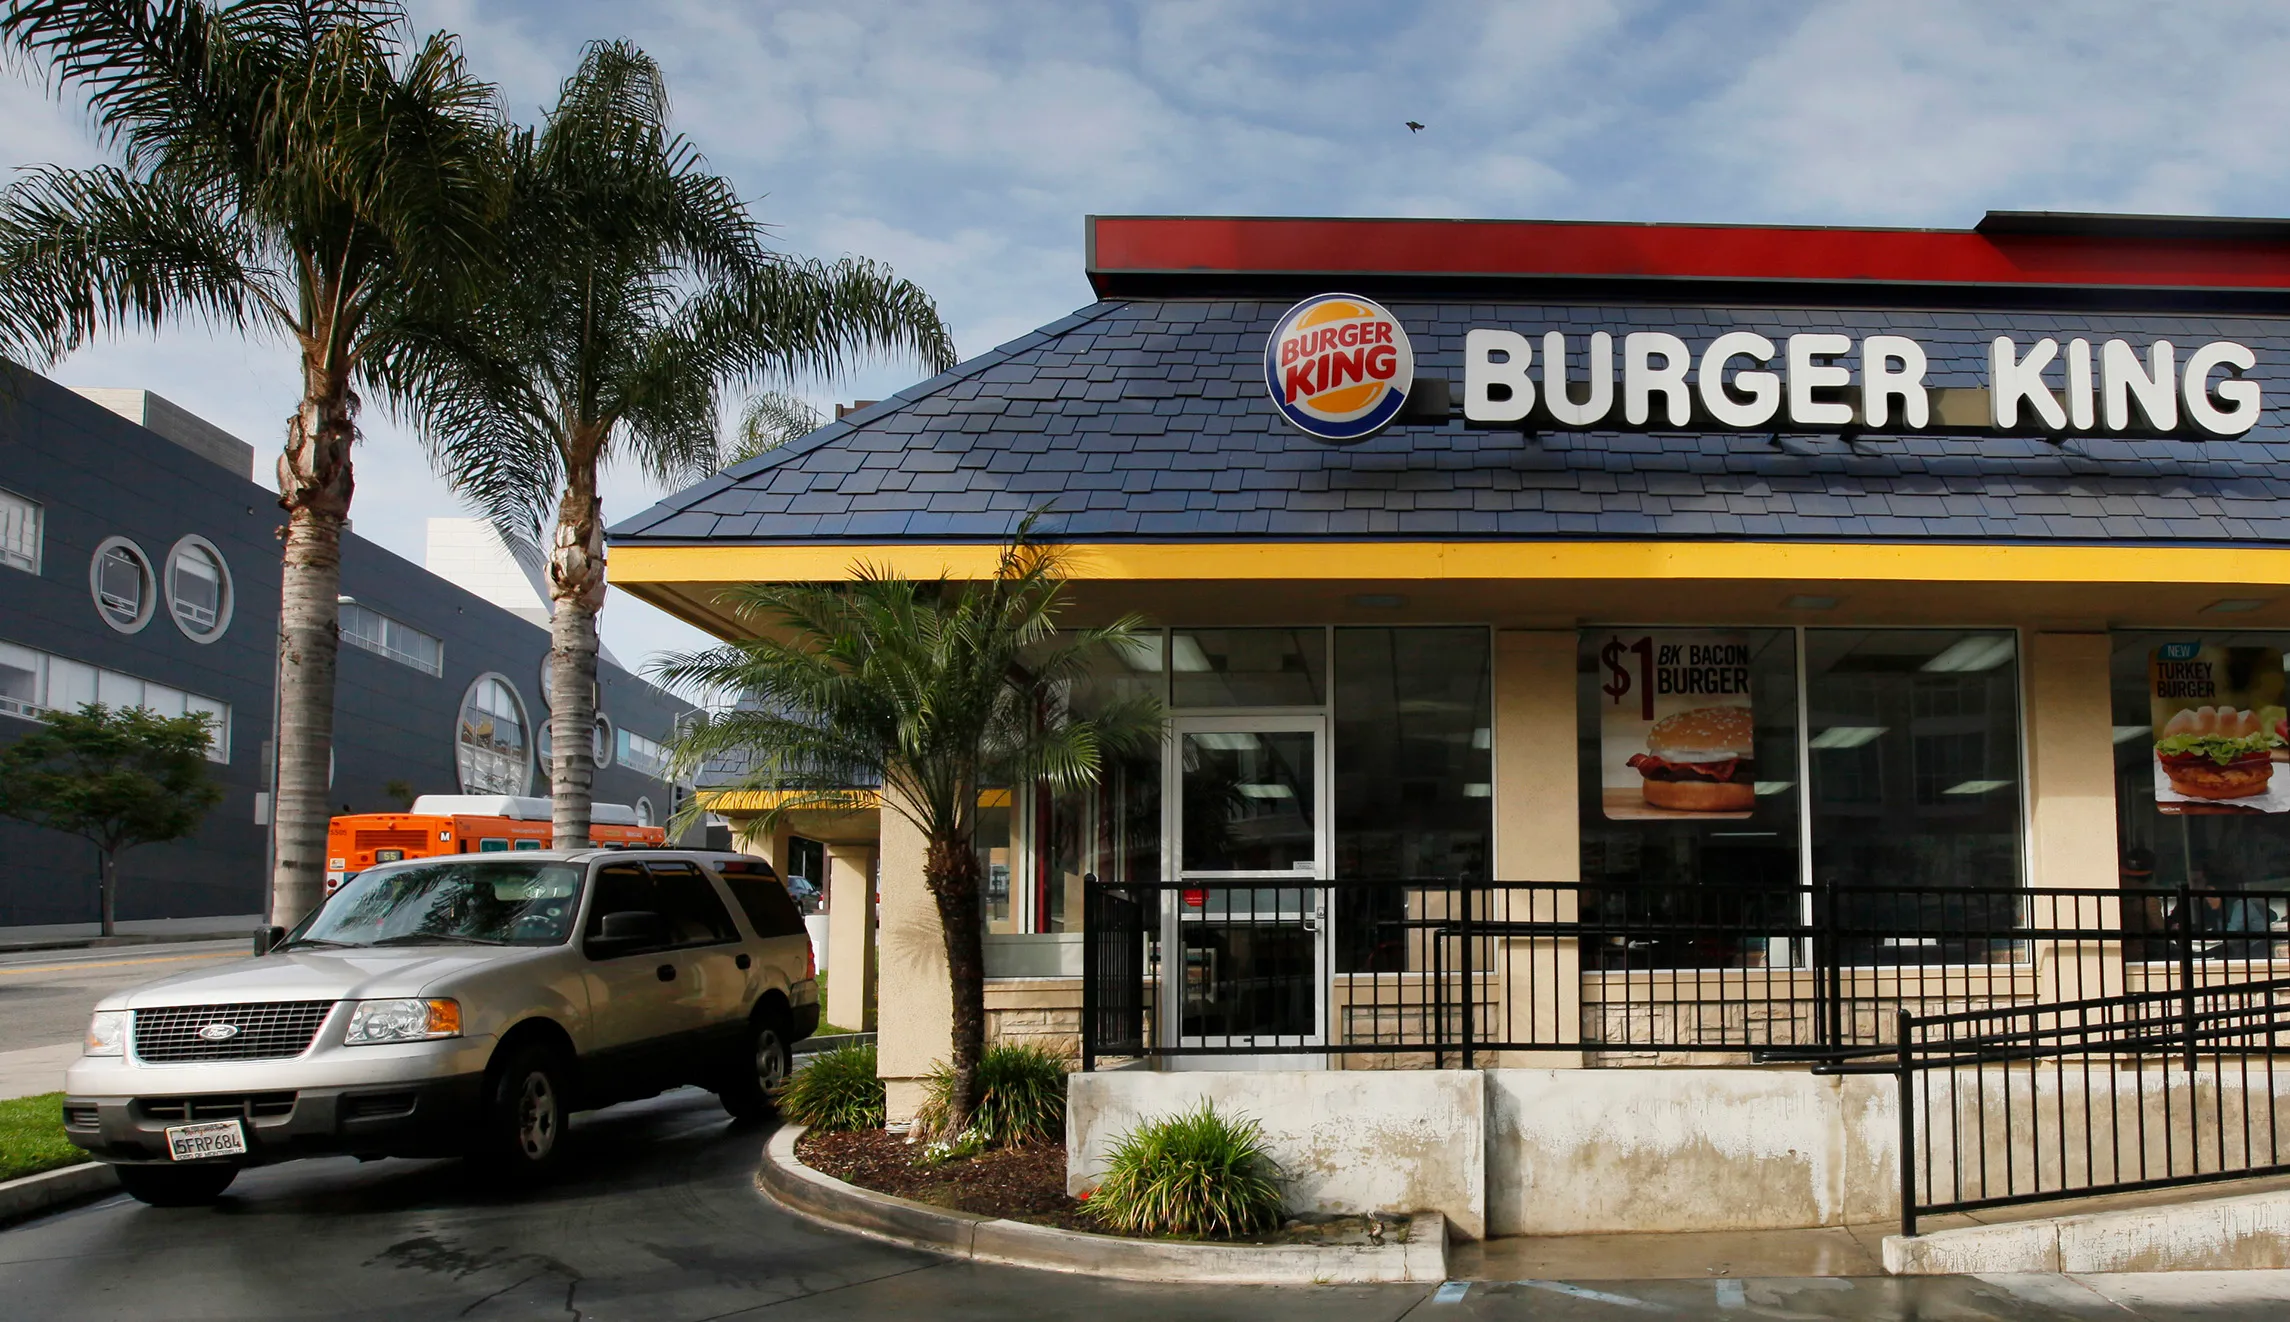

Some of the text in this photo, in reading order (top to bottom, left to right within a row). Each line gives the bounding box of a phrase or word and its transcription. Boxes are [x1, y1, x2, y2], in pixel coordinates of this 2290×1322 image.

[1281, 321, 1393, 367] BURGER
[1286, 344, 1397, 404] KING
[1463, 328, 2262, 436] BURGER KING
[1657, 644, 1749, 666] BK BACON
[2167, 644, 2191, 658] NEW
[1601, 635, 1654, 721] $1
[1657, 667, 1750, 695] BURGER
[2156, 661, 2213, 680] TURKEY
[2156, 680, 2216, 699] BURGER
[207, 1026, 230, 1037] Ford
[174, 1133, 241, 1155] 5FRP684
